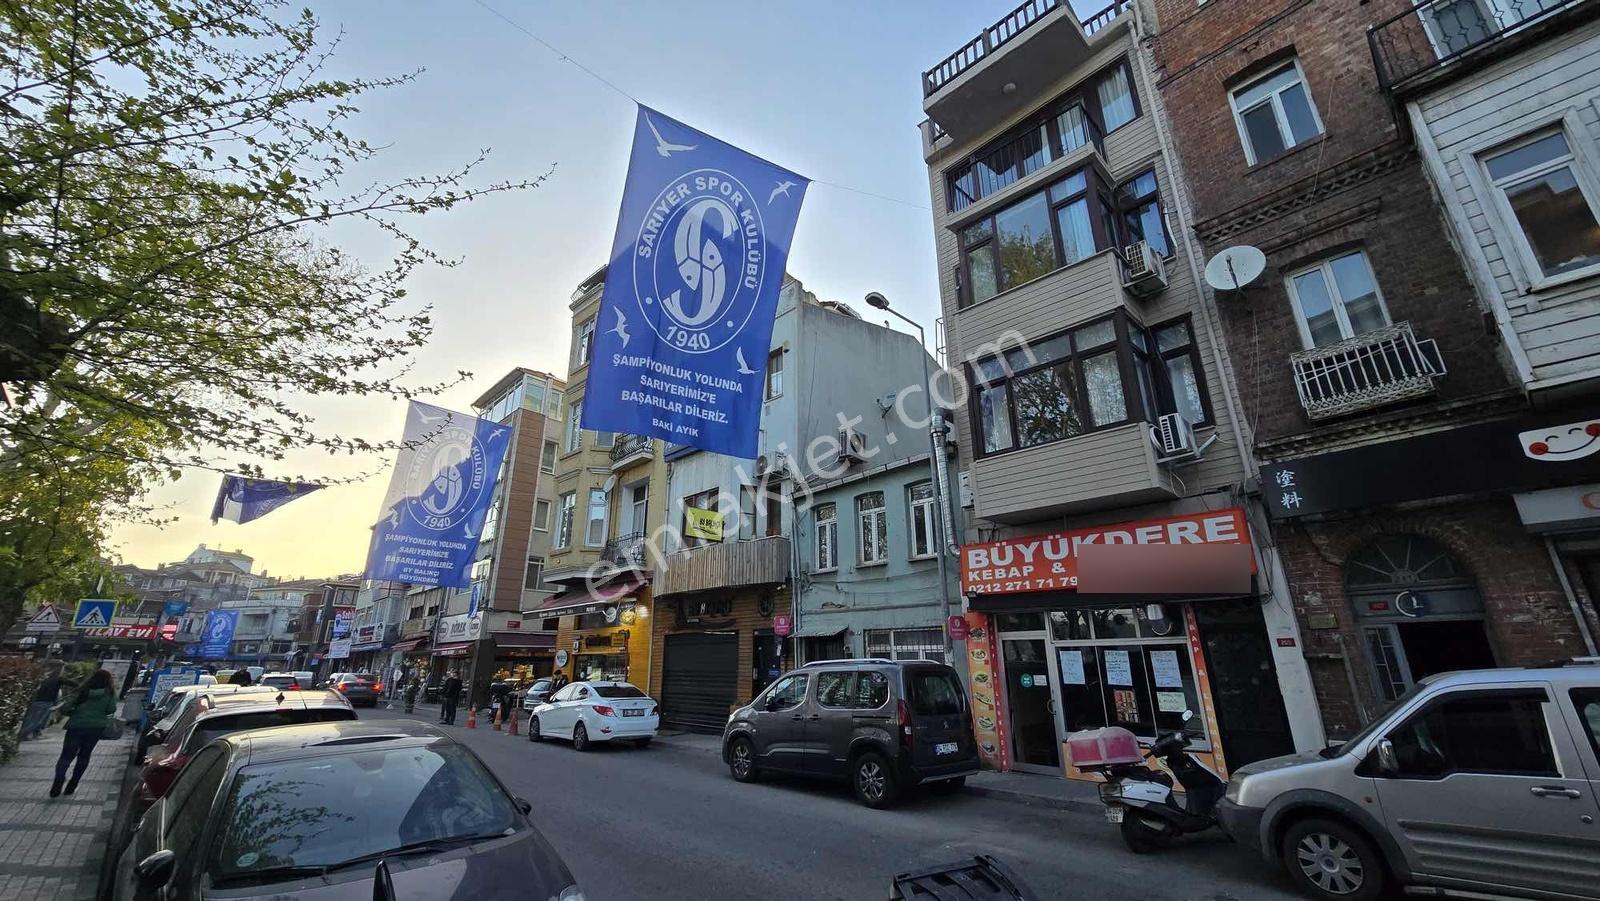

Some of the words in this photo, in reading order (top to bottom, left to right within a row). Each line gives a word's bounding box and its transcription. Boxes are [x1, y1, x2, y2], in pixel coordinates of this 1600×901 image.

[639, 182, 692, 258] SARIYER
[695, 176, 743, 207] SPOR
[740, 209, 761, 289] KULÜBÜ
[665, 325, 711, 350] 1940
[613, 353, 692, 381] ŞAMPİYONLUK
[694, 372, 743, 394] YOLUNDA
[621, 390, 682, 414] BAŞARILAR
[685, 404, 729, 424] DİLERİZ.
[652, 418, 673, 432] BAKİ
[675, 424, 699, 437] AYIK
[423, 514, 451, 528] 1940
[968, 565, 1034, 582] KEBAP
[1051, 562, 1066, 574] &
[968, 582, 1001, 593] 0212
[1005, 580, 1031, 591] 271
[1036, 577, 1054, 588] 71
[1060, 576, 1078, 587] 79
